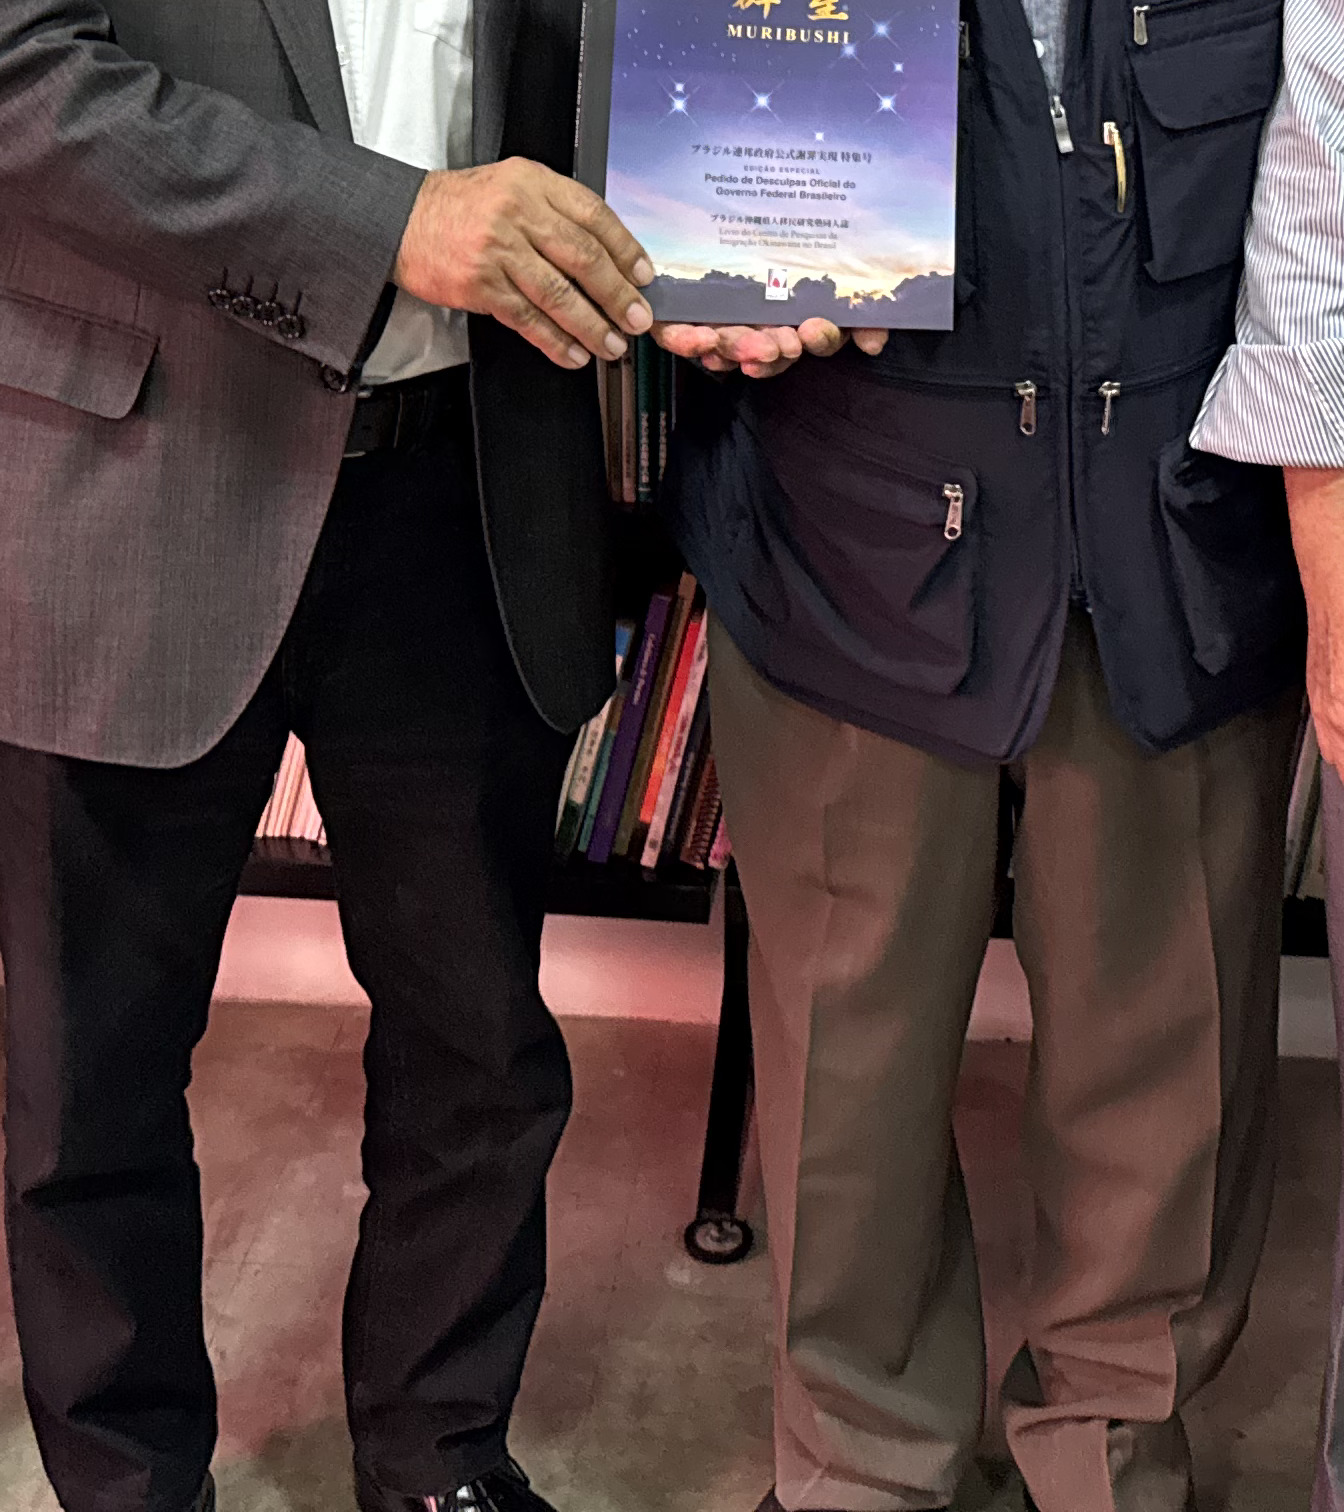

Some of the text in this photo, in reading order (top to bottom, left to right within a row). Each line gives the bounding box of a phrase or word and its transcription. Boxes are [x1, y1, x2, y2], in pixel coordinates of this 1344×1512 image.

[727, 24, 850, 44] MURIBUSHI
[705, 174, 856, 189] Pedido de Desculpas Oficial do
[716, 188, 847, 201] Governo Federal Brasileiro
